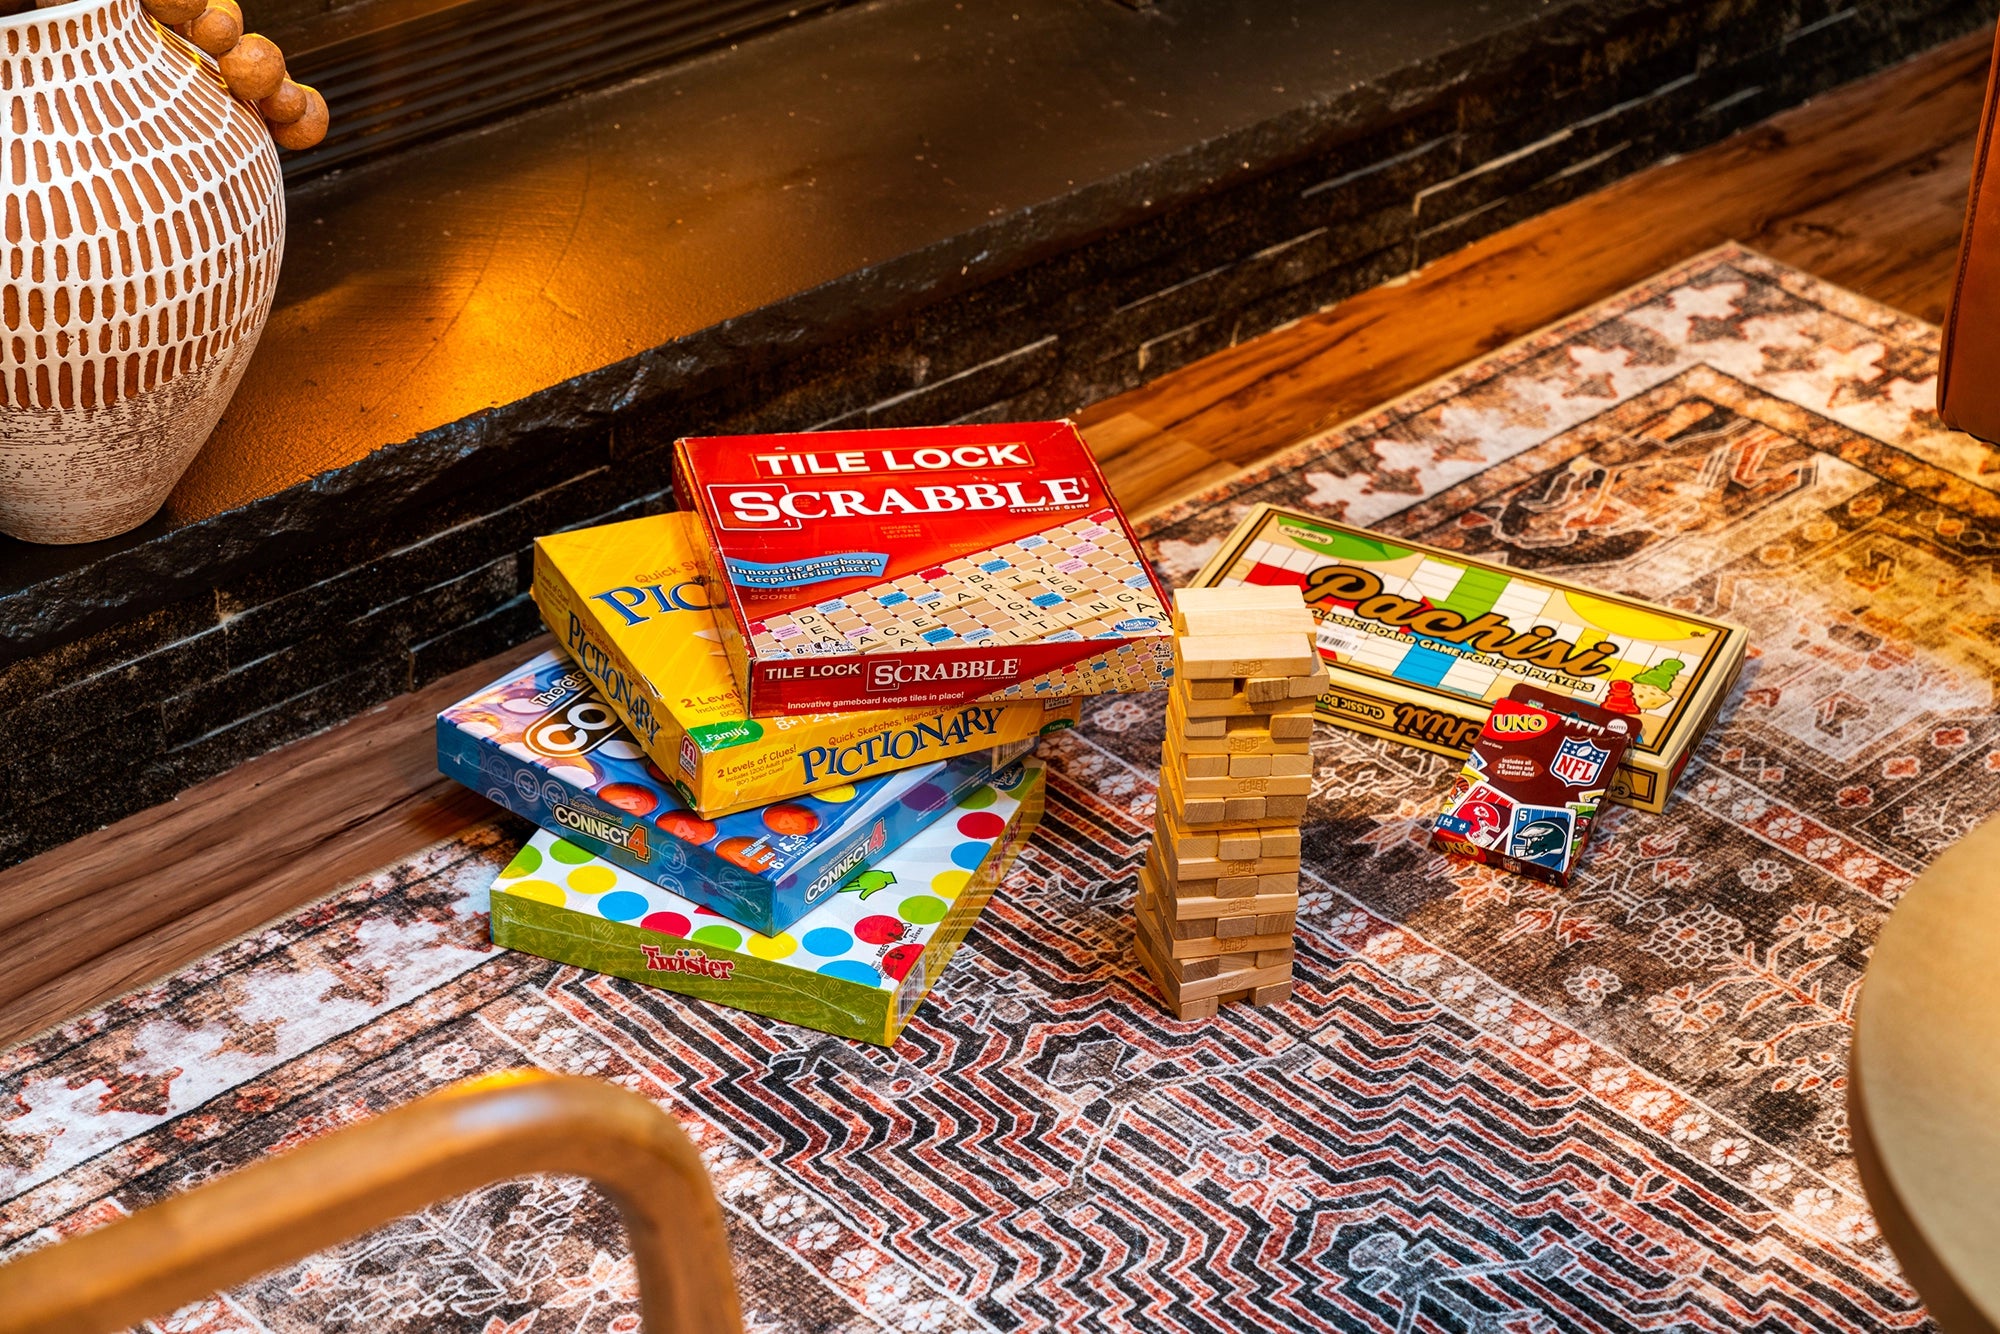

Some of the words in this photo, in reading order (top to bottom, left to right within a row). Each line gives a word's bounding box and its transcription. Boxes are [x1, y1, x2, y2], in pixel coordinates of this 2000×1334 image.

[756, 452, 870, 475] TILE
[882, 444, 1028, 471] LOCK
[729, 477, 1089, 522] SCRABBLE
[1009, 505, 1061, 513] Crossword
[1063, 503, 1090, 511] Game
[634, 566, 679, 583] Quick
[731, 565, 802, 577] Innovative
[805, 558, 881, 571] gameboard
[746, 574, 784, 584] keeps
[787, 571, 814, 581] tiles
[816, 568, 830, 577] in
[834, 564, 872, 575] place!
[1302, 564, 1619, 677] Pachisi
[1312, 608, 1365, 630] CLASSIC
[1365, 622, 1417, 644] BOARD
[1419, 639, 1461, 657] GAME
[1462, 652, 1494, 667] FOR
[1494, 659, 1527, 675] 2-4
[1528, 668, 1595, 692] PLAYERS
[766, 666, 804, 680] TILE
[810, 663, 861, 677] LOCK
[874, 658, 1018, 686] SCRABBLE
[1232, 660, 1262, 675] Jenga
[568, 610, 662, 746] PICTIONARY
[531, 685, 566, 707] The
[681, 699, 695, 708] 2
[787, 701, 830, 709] Innovative
[832, 696, 881, 708] gameboard
[882, 694, 908, 704] keeps
[909, 693, 927, 701] tiles
[929, 692, 937, 700] in
[938, 691, 964, 701] place!
[696, 702, 736, 713] Includes
[1341, 701, 1384, 719] CLASSIC
[828, 731, 855, 745] Quick
[857, 720, 902, 737] Sketches,
[904, 708, 938, 723] Hilarious
[1493, 714, 1548, 733] UNO
[705, 727, 750, 742] Family
[797, 705, 1004, 785] PICTIONARY
[717, 769, 725, 778] 2
[727, 760, 755, 775] Levels
[757, 754, 767, 765] of
[769, 744, 796, 760] Clues!
[1556, 755, 1593, 781] NFL
[726, 772, 748, 782] Includes
[766, 760, 780, 769] Adult
[751, 773, 767, 782] Junior
[768, 765, 784, 775] Clues!
[1477, 788, 1488, 799] 7
[1519, 810, 1528, 821] 5
[555, 806, 629, 847] CONNECT
[628, 827, 649, 859] 4
[1433, 840, 1479, 857] UNO
[757, 852, 775, 865] AGES
[807, 839, 870, 900] CONNECT
[868, 821, 885, 852] 4
[910, 927, 924, 943] PLAYERS
[875, 944, 889, 958] AGES
[641, 944, 735, 980] Twister
